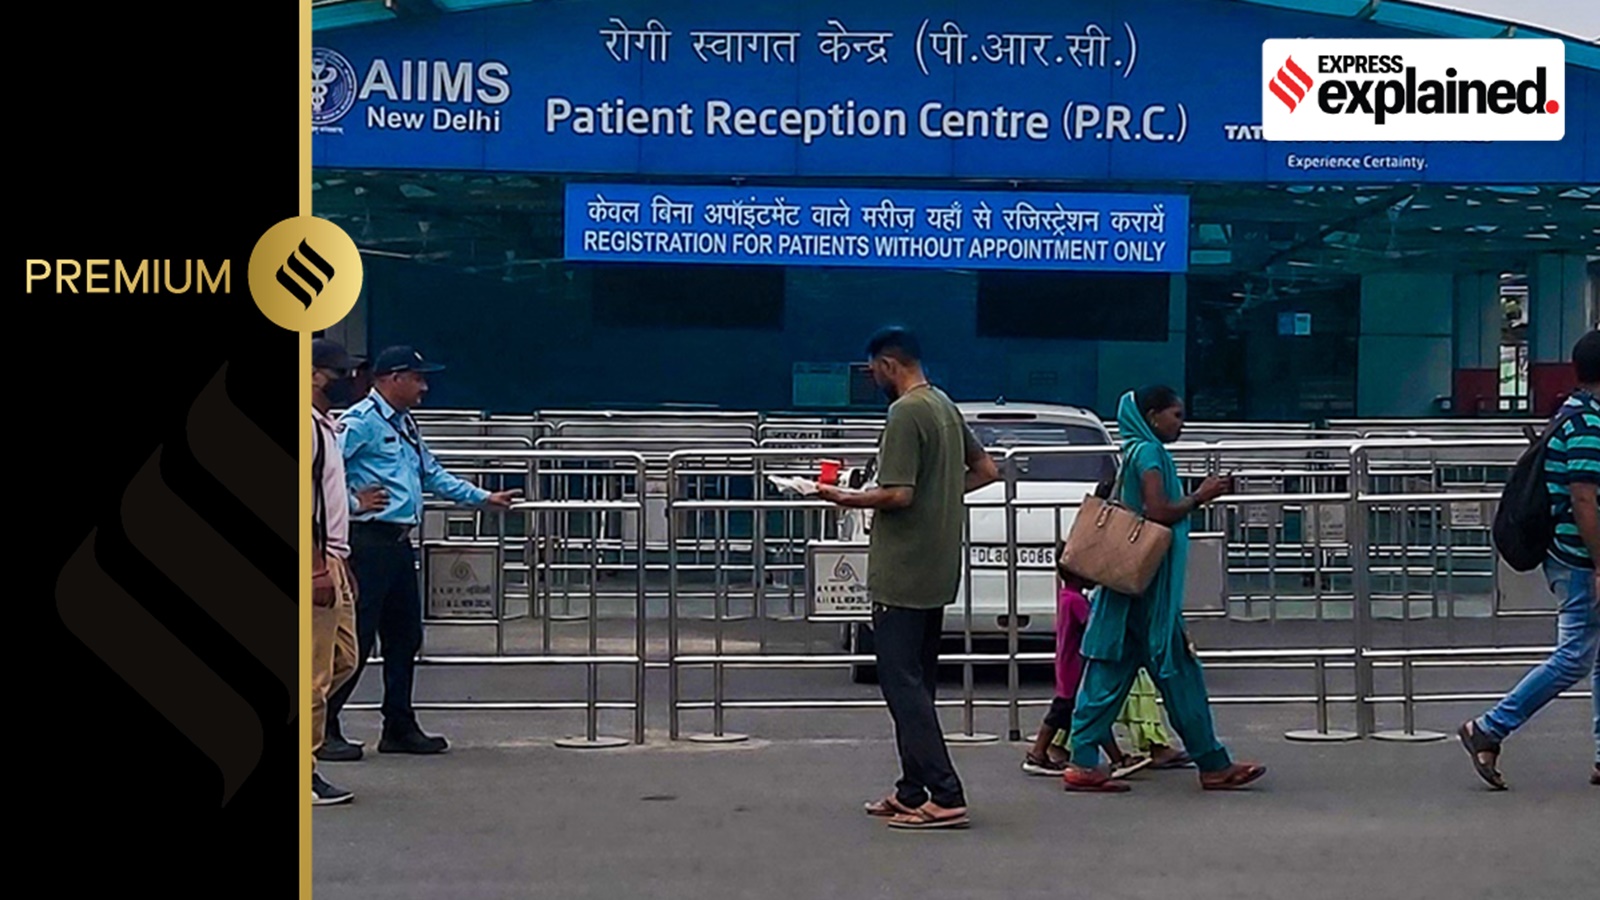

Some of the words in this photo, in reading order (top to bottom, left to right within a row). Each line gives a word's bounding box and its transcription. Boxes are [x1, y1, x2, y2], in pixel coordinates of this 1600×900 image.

[600, 19, 671, 60] रोगी
[691, 33, 800, 62] स्वागत
[818, 21, 892, 62] केन्द्र
[917, 20, 1135, 76] (पी.आर.सी.)
[358, 59, 511, 104] AIIMS
[369, 107, 424, 128] New
[433, 108, 500, 132] Delhi
[548, 99, 692, 134] Patient
[708, 101, 905, 143] Reception
[921, 103, 1048, 138] Centre
[1064, 102, 1186, 141] (P.R.C.)
[1224, 125, 1265, 140] TAT
[1287, 154, 1361, 169] Experience
[1363, 155, 1428, 170] Certainty.
[589, 195, 639, 222] केवल
[652, 196, 692, 223] बिना
[812, 200, 849, 226] वाले
[927, 202, 961, 230] यहाँ
[973, 202, 991, 228] से
[1111, 205, 1164, 232] करायें
[585, 231, 725, 252] REGISTRATION
[734, 234, 771, 253] FOR
[780, 235, 868, 255] PATIENTS
[876, 237, 964, 257] WITHOUT
[969, 239, 1108, 259] APPOINTMENT
[1115, 241, 1165, 260] ONLY
